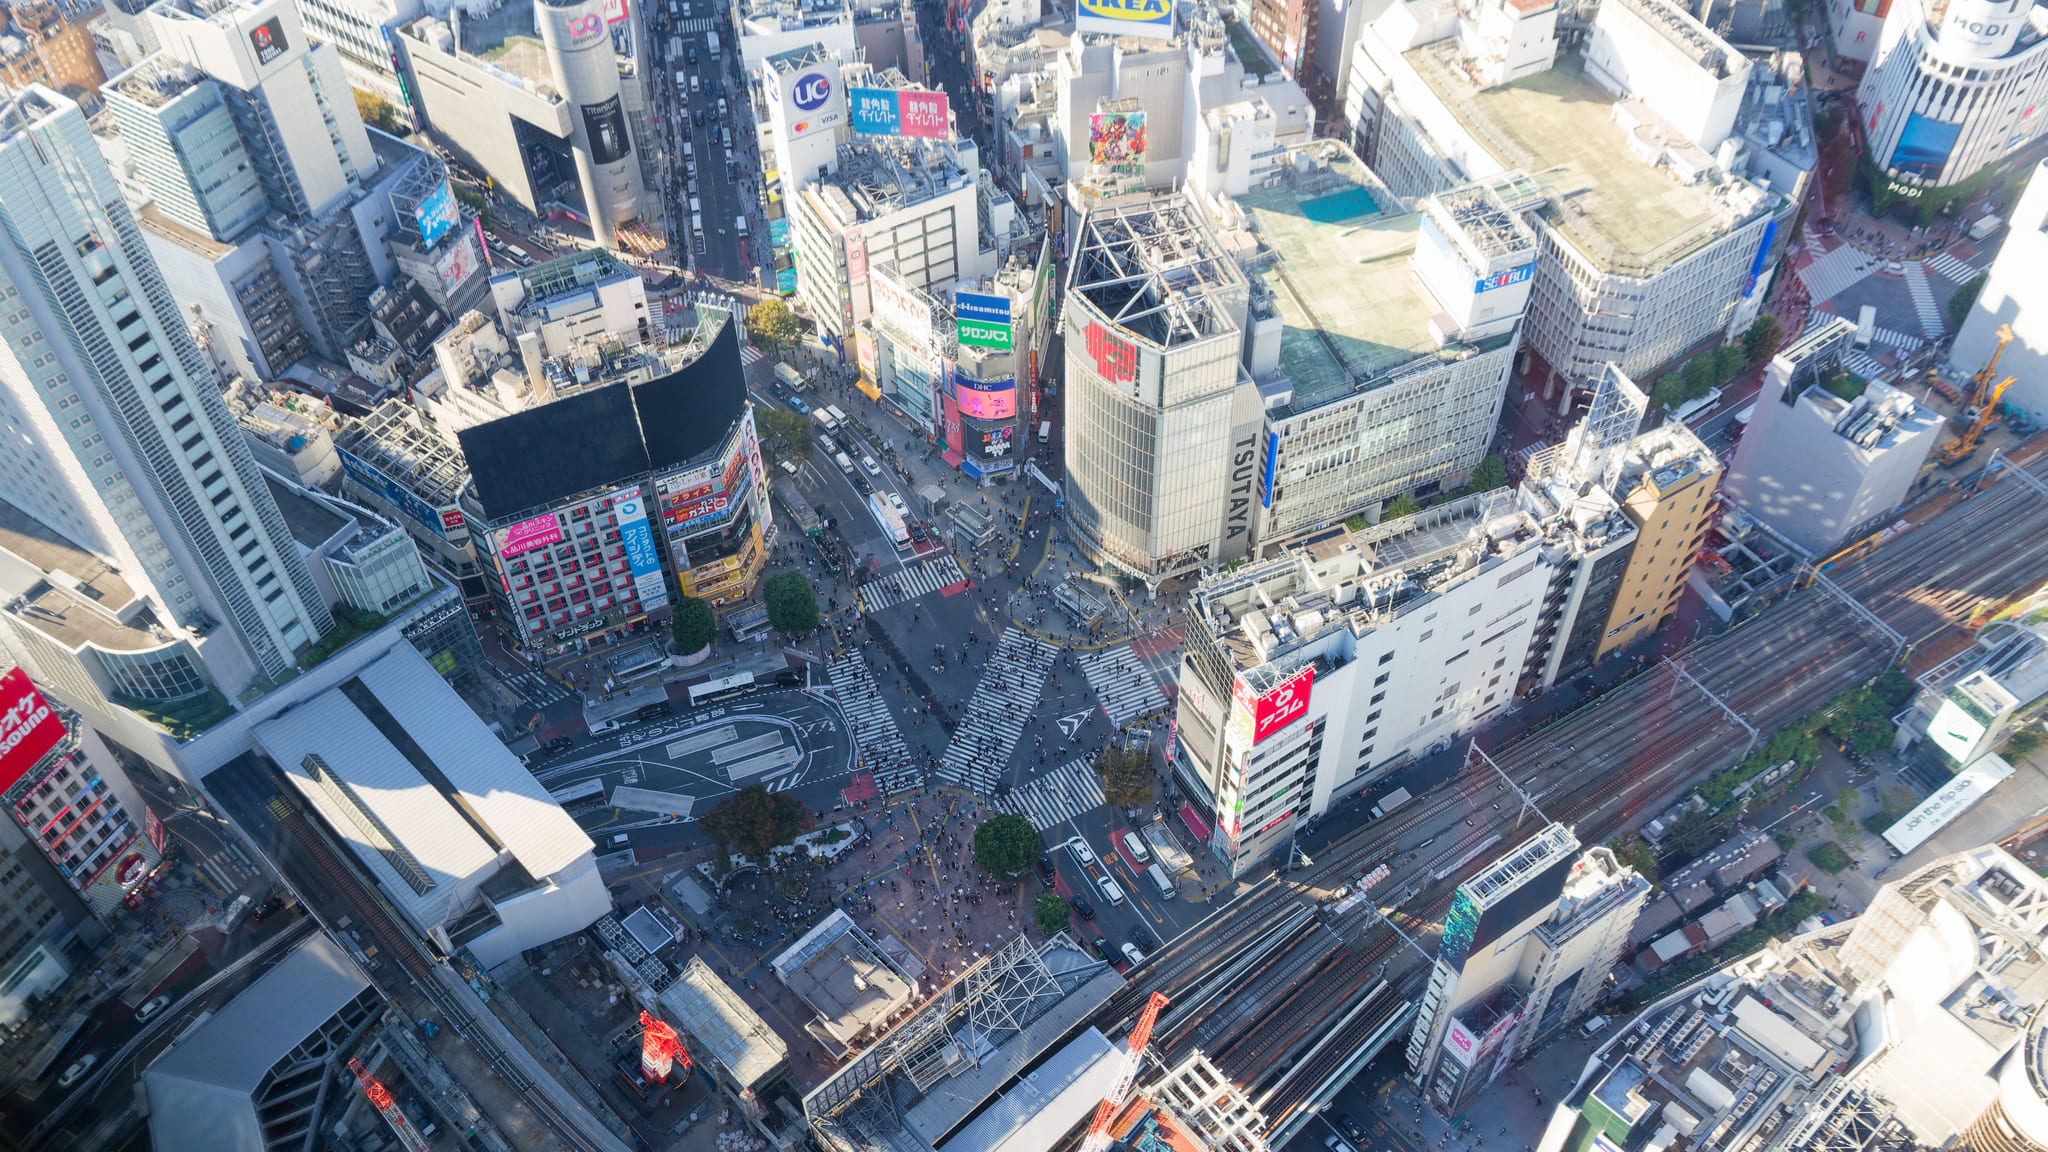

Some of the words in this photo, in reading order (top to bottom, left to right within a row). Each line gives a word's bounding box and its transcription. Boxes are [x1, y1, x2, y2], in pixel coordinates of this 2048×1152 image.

[565, 13, 603, 39] 109
[1953, 15, 2009, 37] MODI
[794, 81, 829, 105] UC
[584, 99, 619, 115] Titanium
[821, 113, 838, 125] VISA
[1888, 181, 1923, 198] MODI
[1483, 269, 1527, 290] SEIBU
[957, 302, 1010, 316] Hisamitsu
[961, 326, 1009, 342] サロンパス
[974, 383, 993, 391] DHC
[1226, 432, 1257, 540] TSUTAYA
[1259, 698, 1304, 732] アコム
[1906, 814, 1927, 831] Join
